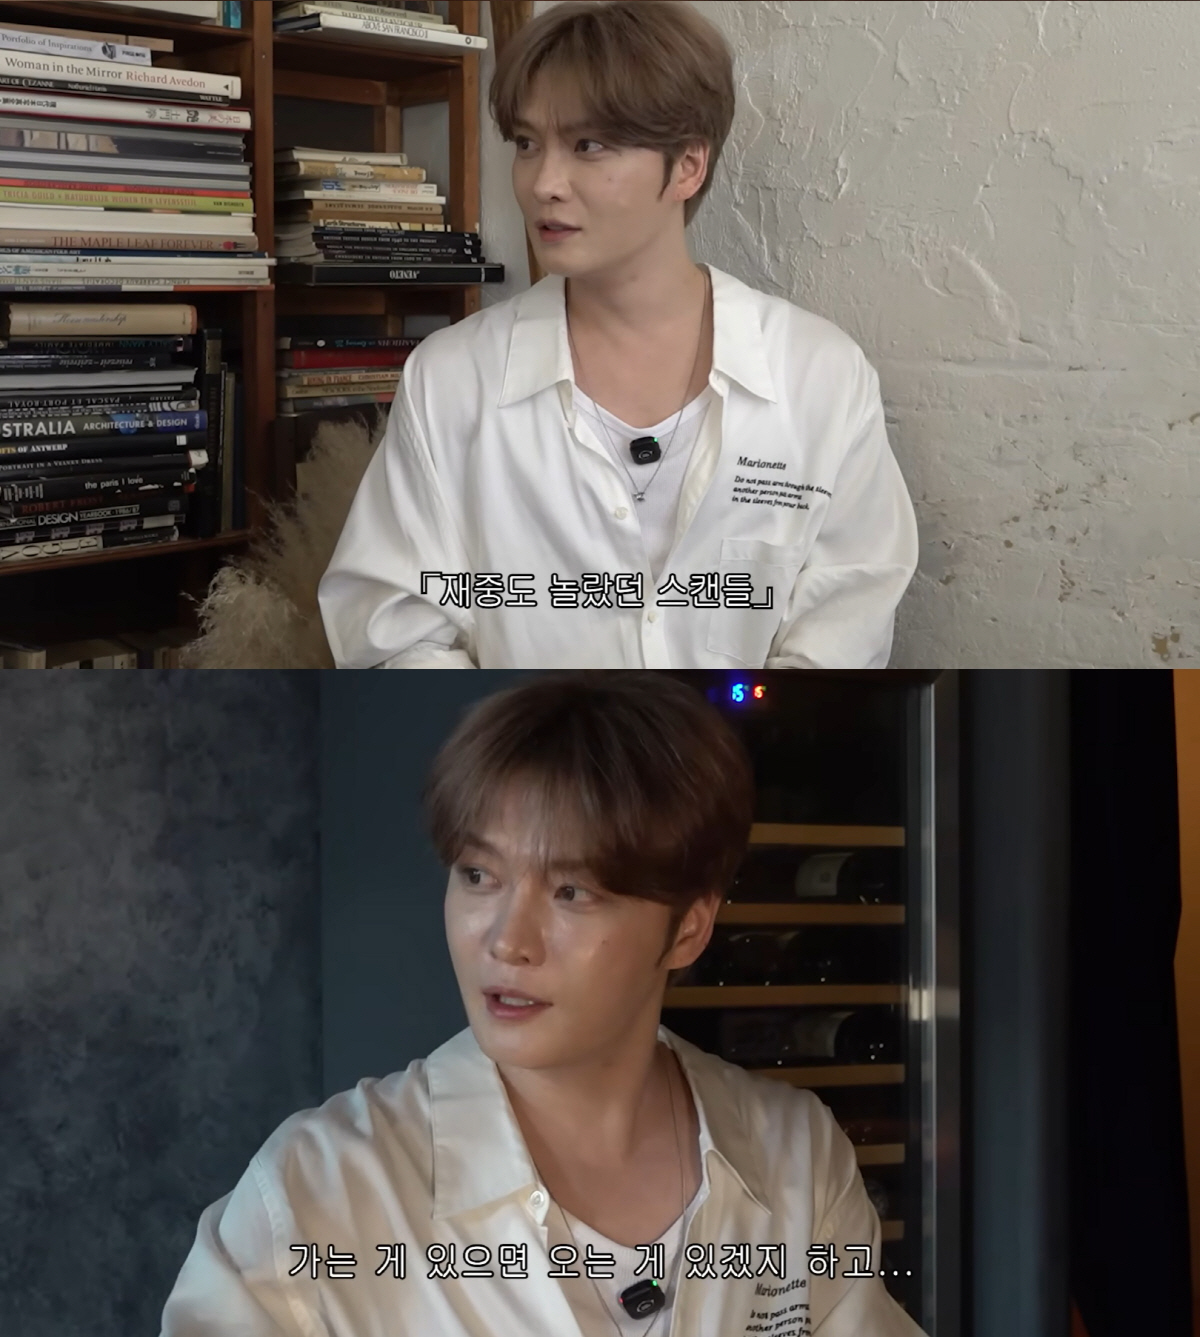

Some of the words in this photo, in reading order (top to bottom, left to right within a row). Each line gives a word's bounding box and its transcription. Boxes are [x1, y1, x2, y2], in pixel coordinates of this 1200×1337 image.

[362, 21, 380, 30] ABOVE
[382, 23, 394, 33] SAN
[394, 24, 424, 38] FRANCISCO
[2, 34, 36, 46] Portfolio
[38, 38, 46, 46] of
[47, 38, 93, 52] Inspirations
[4, 57, 50, 72] Woman
[52, 61, 64, 72] in
[66, 62, 84, 76] the
[86, 65, 122, 80] Mirror
[126, 70, 168, 84] Richard
[170, 76, 206, 89] Avedon
[4, 190, 30, 200] TRICIA
[32, 191, 54, 200] GUILD
[50, 236, 81, 248] THE
[84, 237, 124, 248] MAPLE
[128, 238, 158, 249] LEAF
[159, 240, 214, 250] FOREVER
[87, 396, 120, 404] PASCAL
[1, 420, 76, 438] STRALIA
[83, 419, 145, 431] ARCHITECTURE
[148, 418, 154, 428] &
[156, 418, 188, 428] DESIGN
[30, 444, 68, 452] ANTWERP
[736, 456, 787, 470] Marionette
[84, 482, 98, 490] the
[100, 480, 120, 490] paris
[128, 476, 144, 485] love
[734, 476, 744, 484] Do
[733, 486, 759, 495] another
[759, 488, 779, 496] person
[22, 500, 66, 514] ROBERT
[740, 496, 751, 504] the
[752, 498, 773, 506] sleeves
[38, 513, 79, 526] DESIGN
[770, 1308, 788, 1321] pass
[774, 1317, 804, 1330] person
